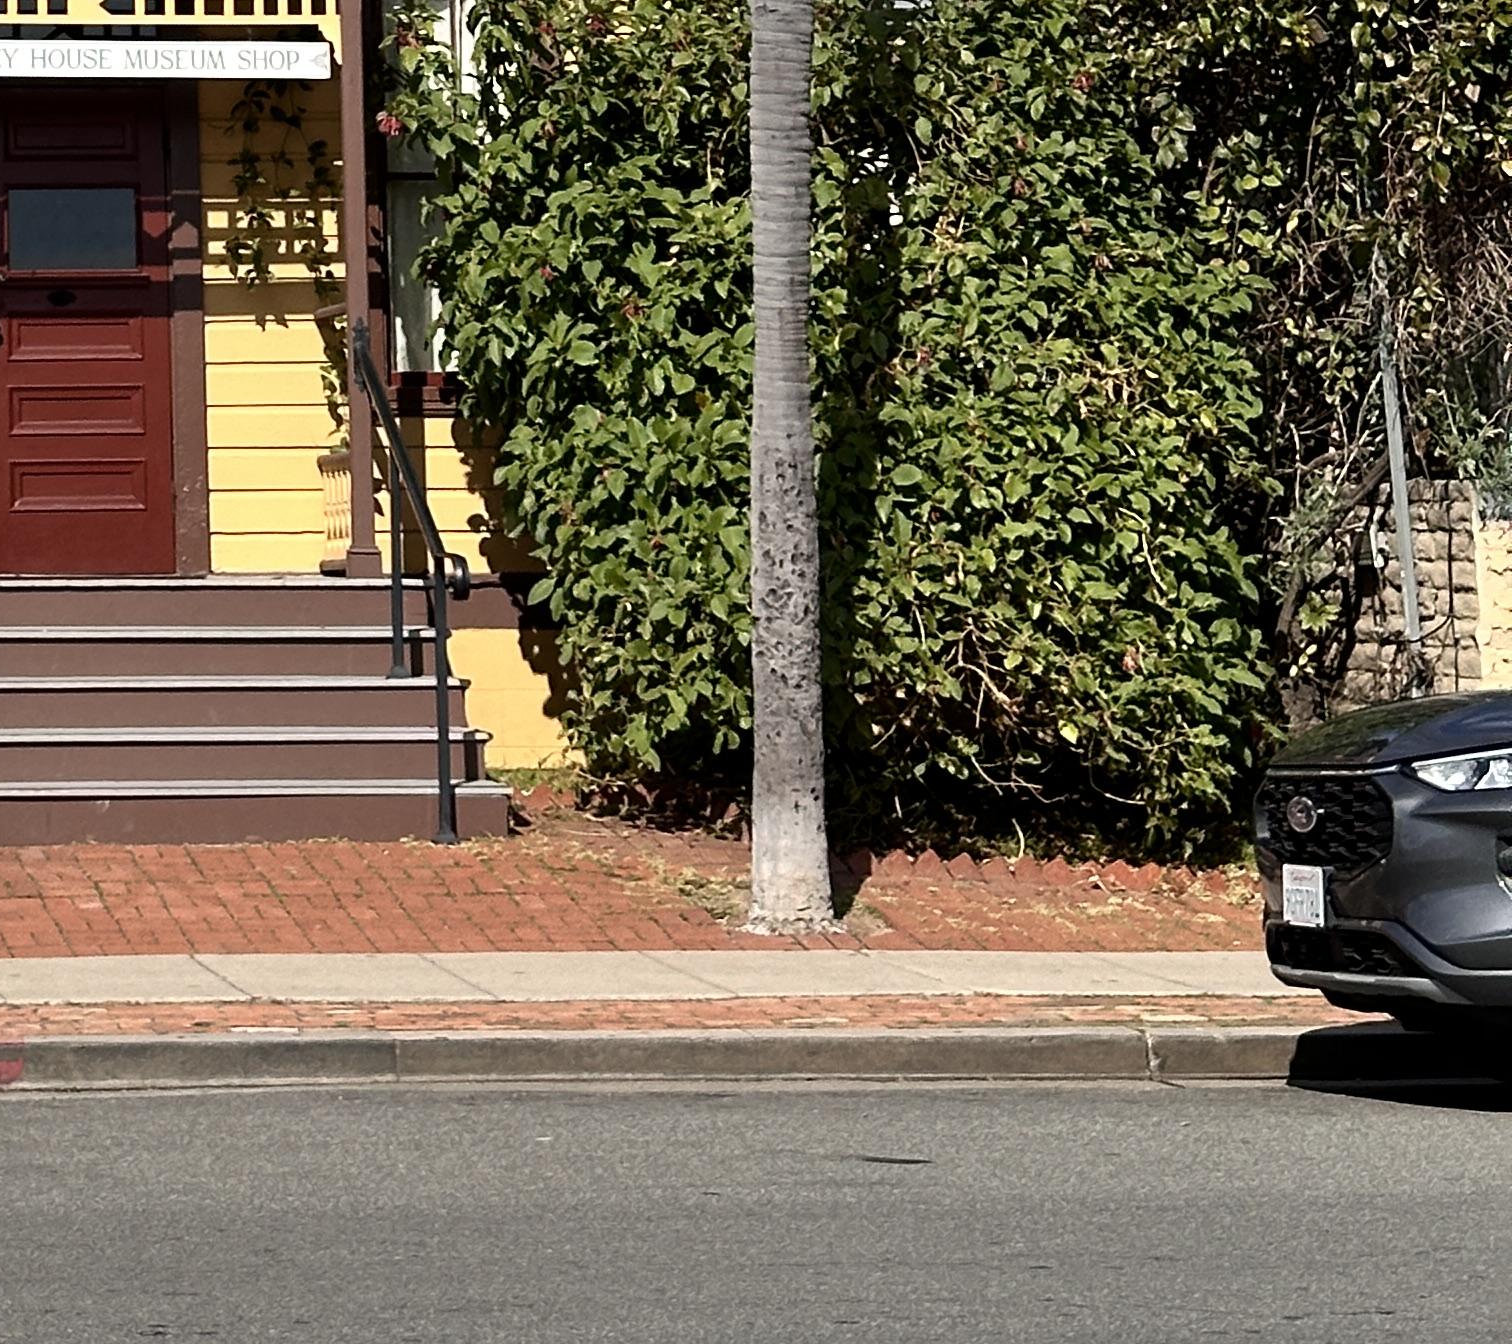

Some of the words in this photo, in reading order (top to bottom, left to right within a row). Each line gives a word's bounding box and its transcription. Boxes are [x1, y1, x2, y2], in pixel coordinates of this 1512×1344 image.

[31, 48, 112, 69] HOUSE
[124, 49, 226, 70] MUSEUM
[238, 50, 299, 71] SHOP
